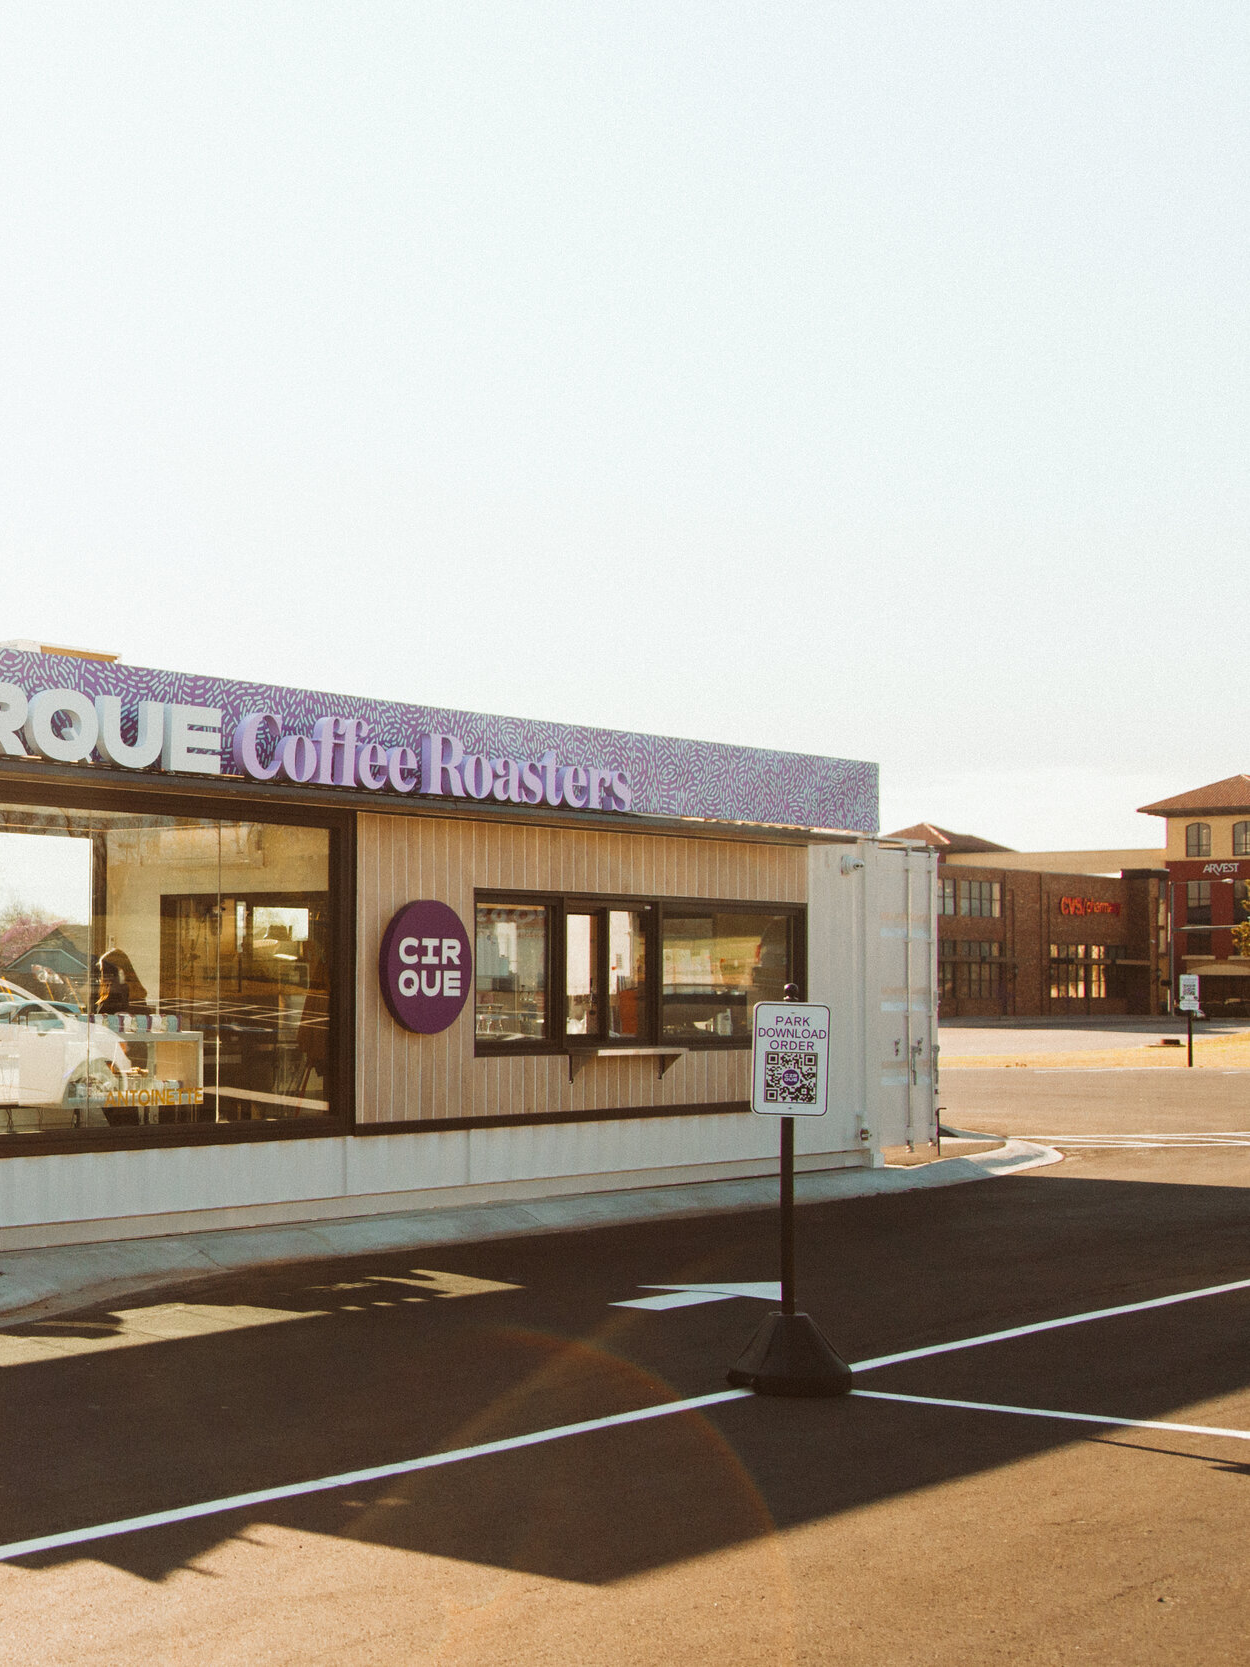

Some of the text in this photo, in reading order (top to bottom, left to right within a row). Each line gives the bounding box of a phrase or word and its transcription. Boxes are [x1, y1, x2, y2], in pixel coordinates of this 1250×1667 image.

[233, 711, 418, 794] Coffee
[420, 733, 633, 812] Roasters
[1202, 862, 1240, 876] ARVEST
[398, 937, 462, 965] CIR
[398, 969, 462, 997] QUE
[775, 1016, 811, 1027] PARK
[758, 1027, 827, 1040] DOWNLOAD
[769, 1040, 815, 1051] ORDER
[104, 1087, 204, 1107] ANTOINETTE
